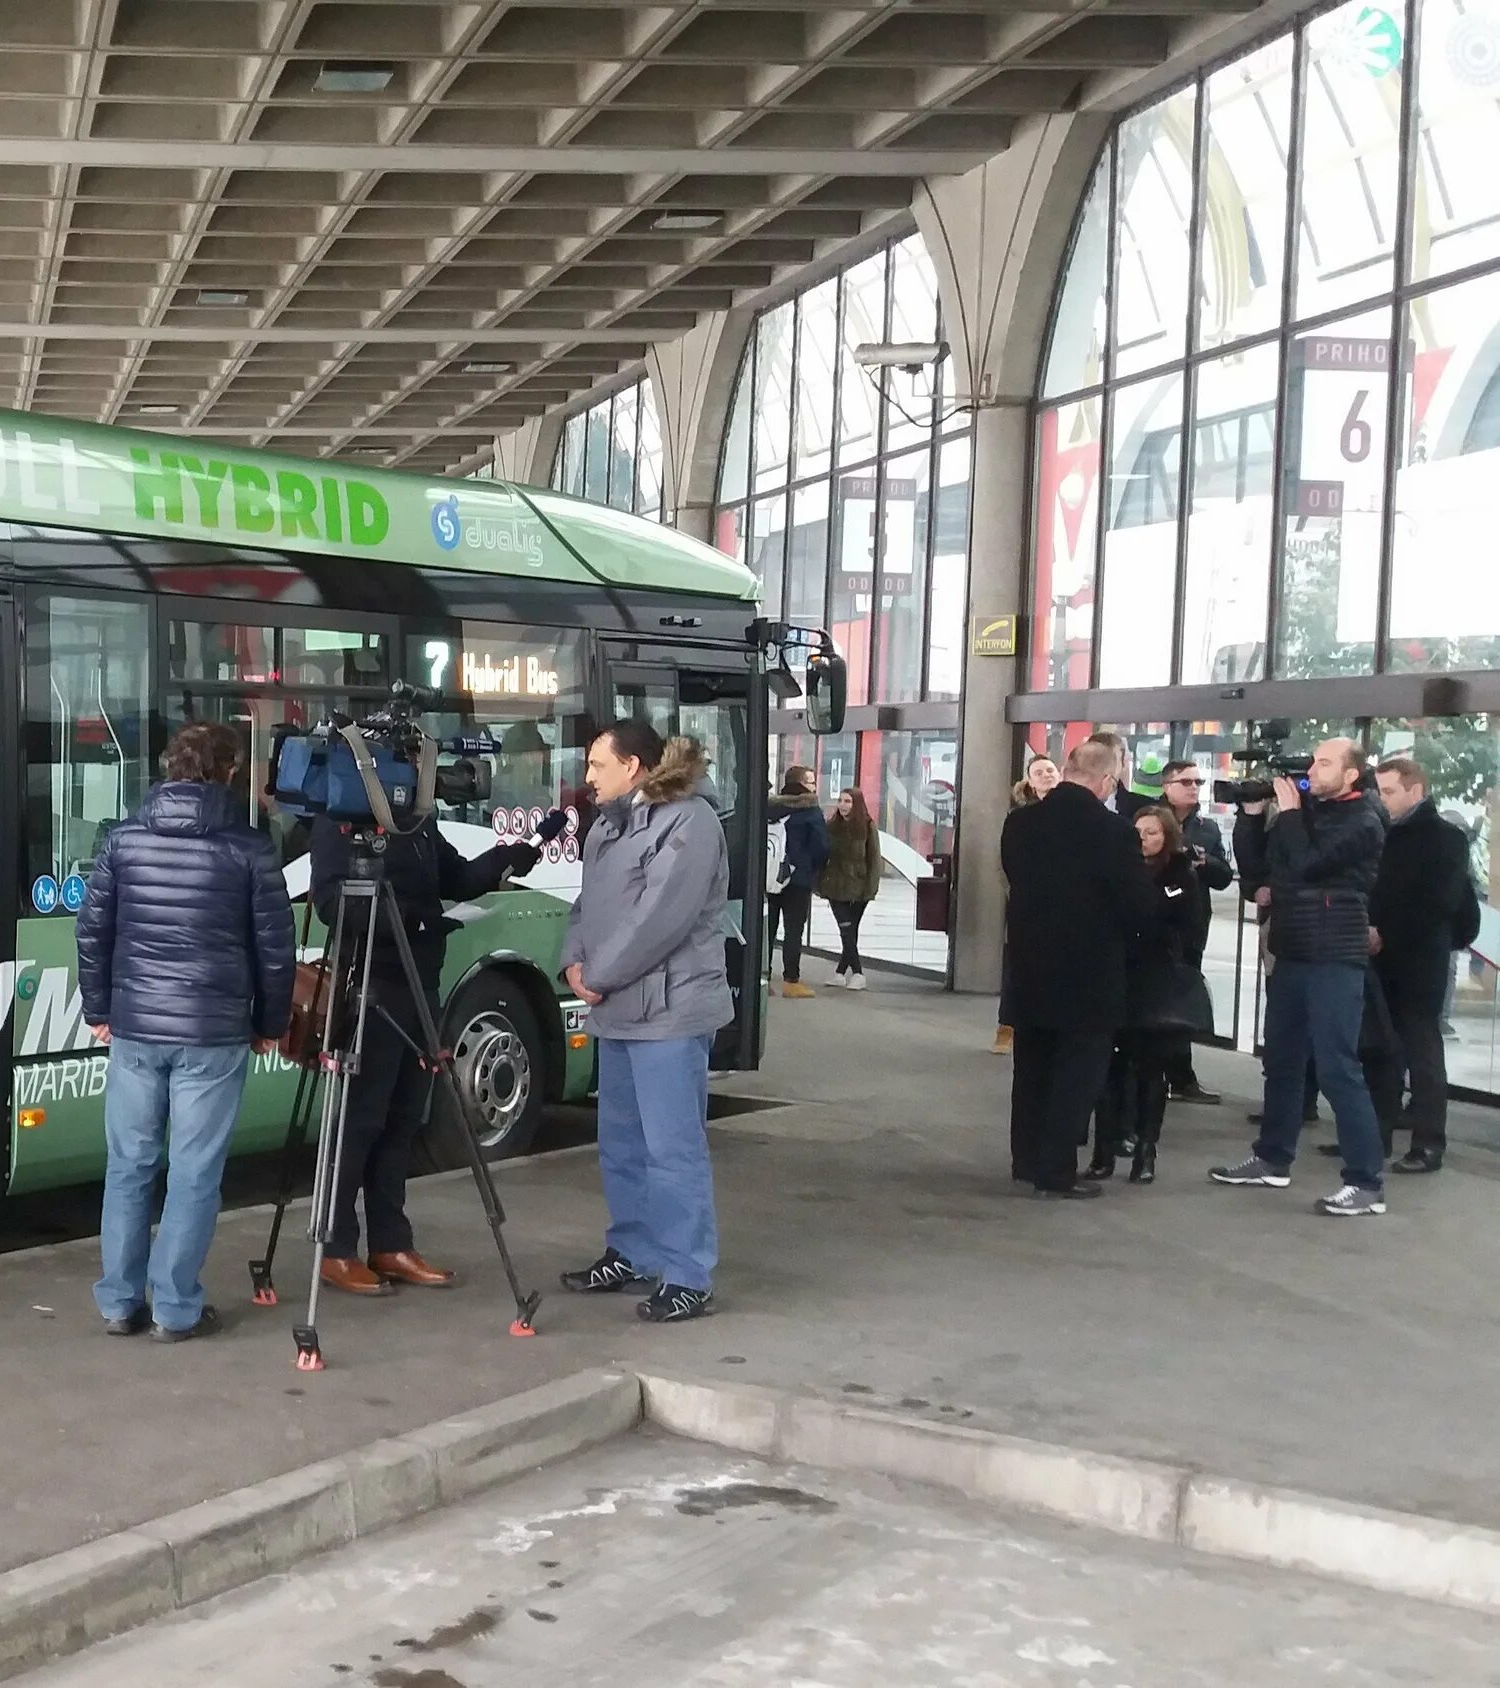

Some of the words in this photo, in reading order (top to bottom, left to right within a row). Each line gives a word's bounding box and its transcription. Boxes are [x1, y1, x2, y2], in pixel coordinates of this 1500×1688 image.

[1315, 343, 1387, 364] PRIHO
[1340, 390, 1371, 463] 6
[130, 447, 389, 546] HYBRID
[852, 480, 909, 497] PRIOD
[1308, 489, 1340, 508] OD
[466, 517, 543, 567] dualis
[848, 576, 905, 592] ODOD
[975, 639, 1011, 649] INTERFON
[425, 641, 449, 688] 7
[462, 652, 519, 693] Hybrid
[526, 656, 559, 695] Bus
[7, 1056, 109, 1107] MARIB
